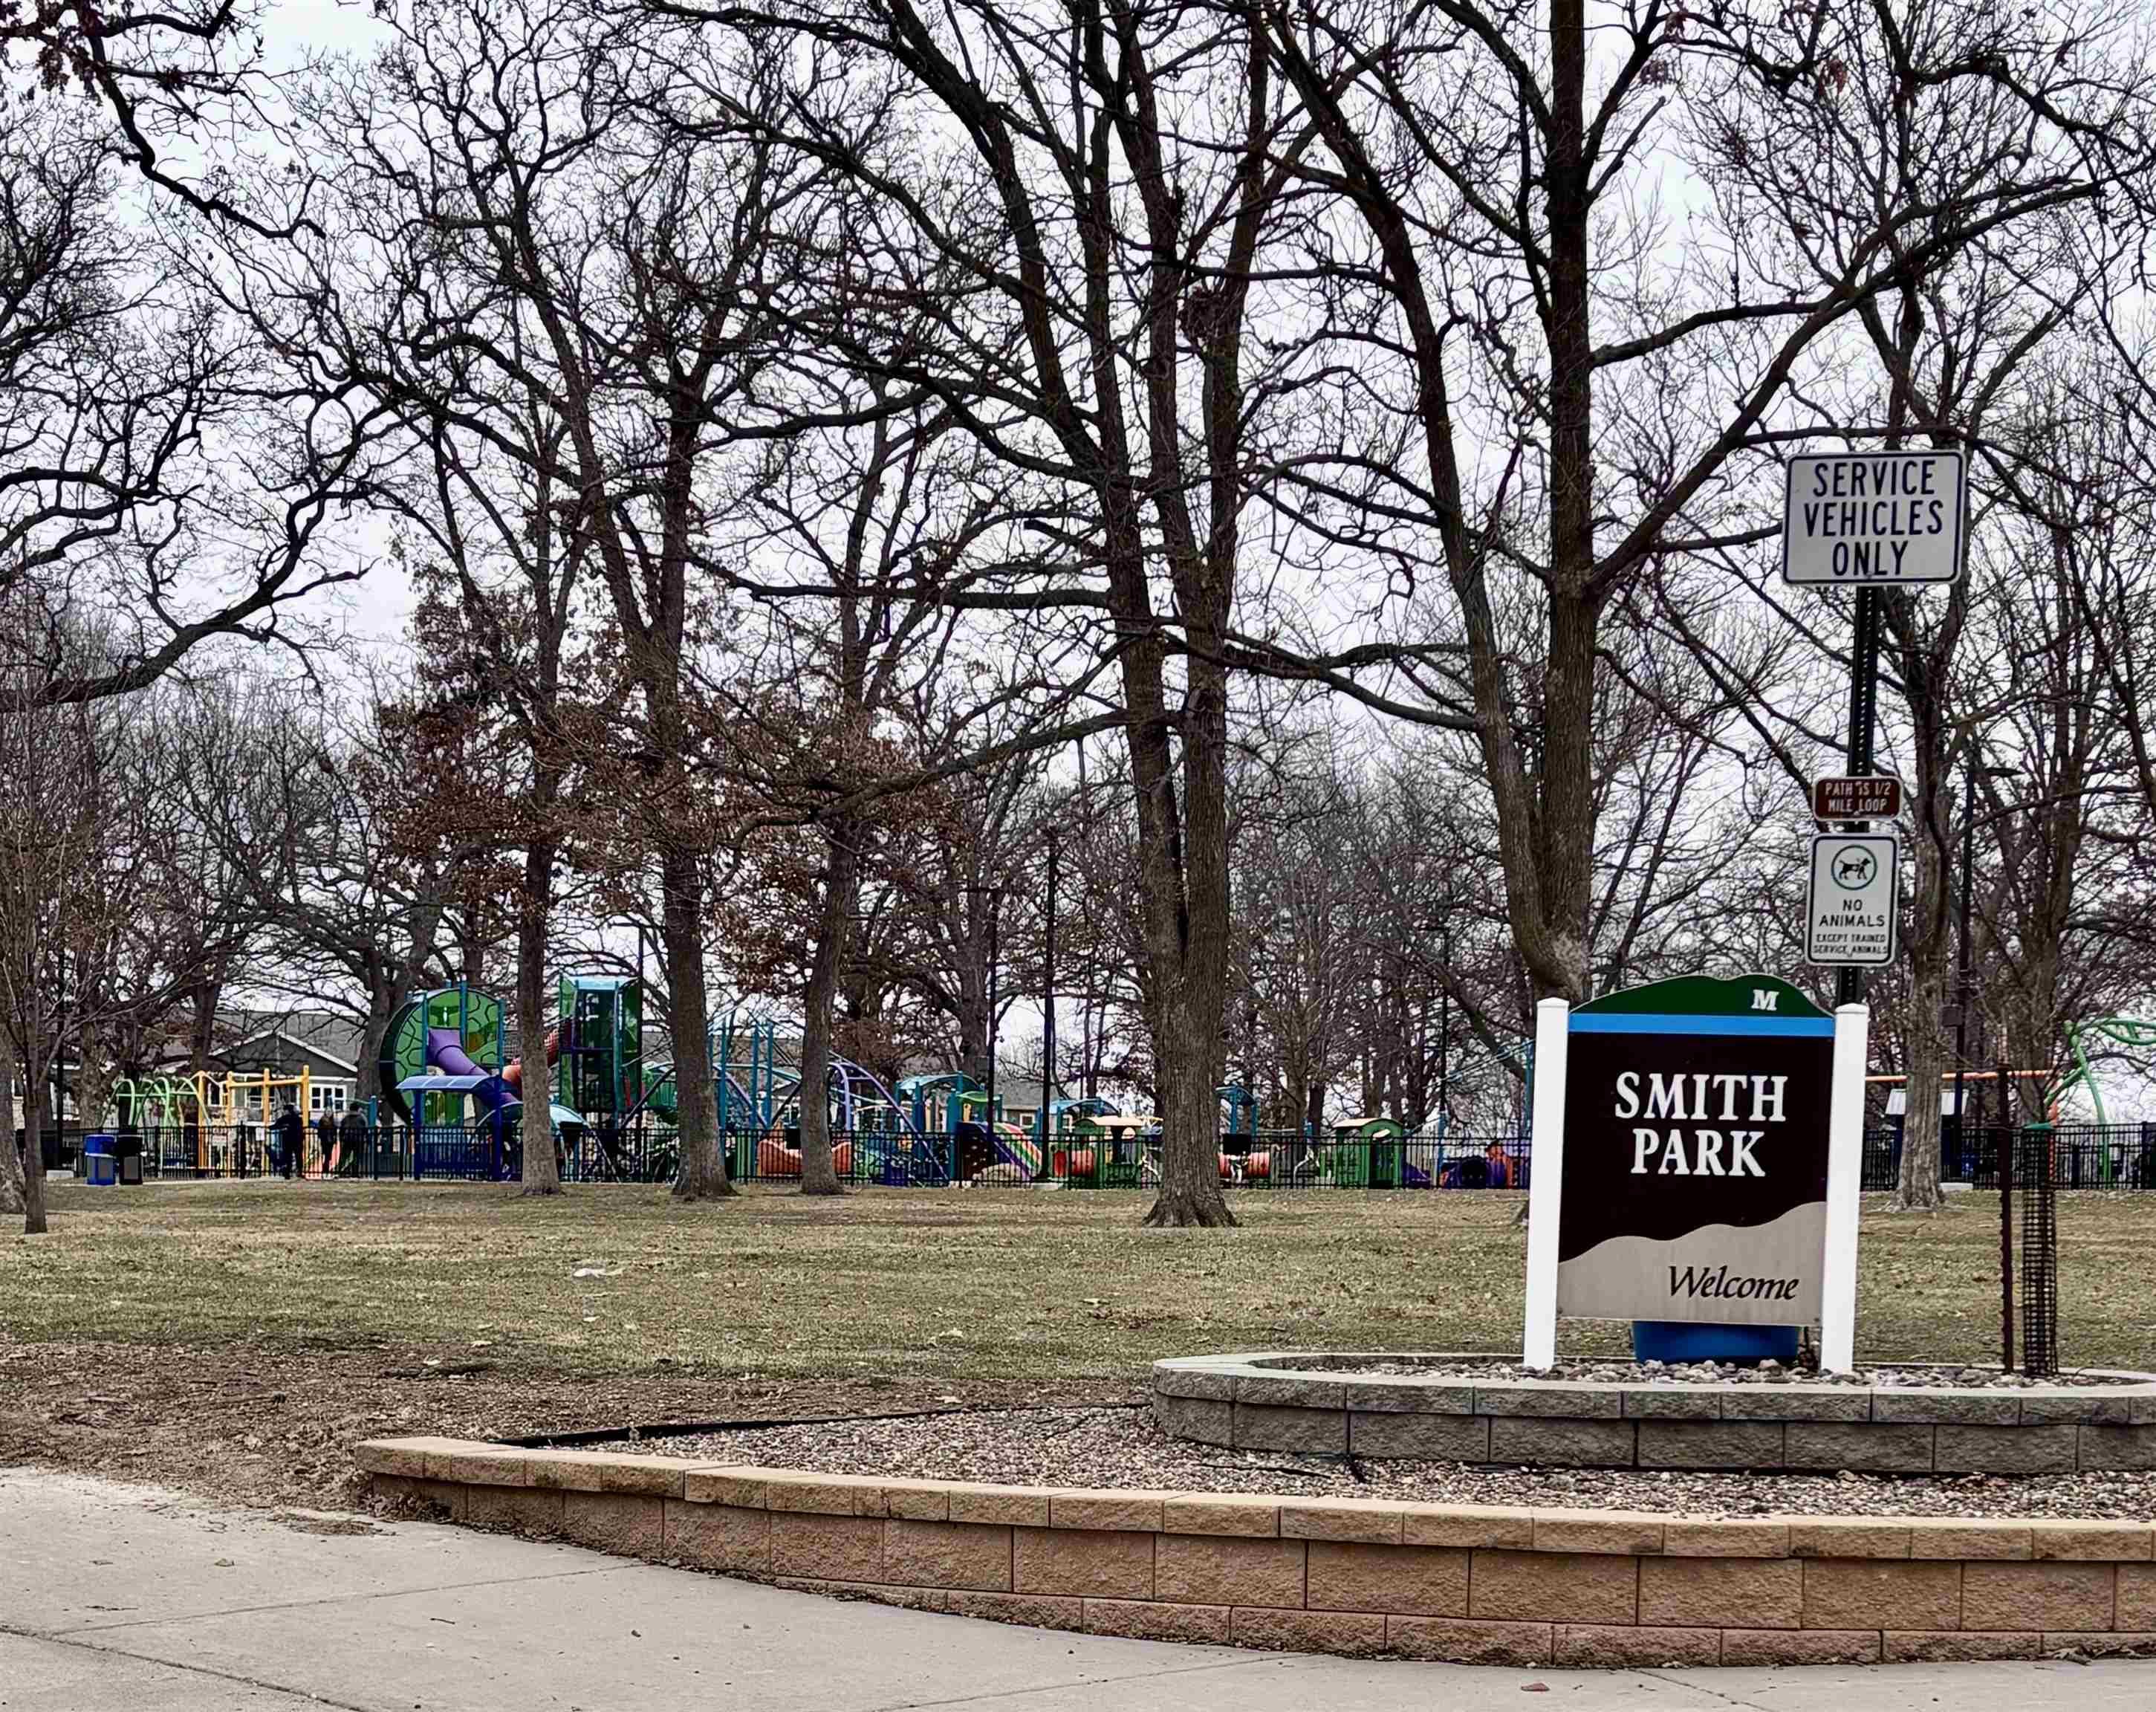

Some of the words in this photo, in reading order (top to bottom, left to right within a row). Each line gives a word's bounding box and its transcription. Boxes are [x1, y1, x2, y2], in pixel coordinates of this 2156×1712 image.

[1813, 460, 1936, 497] SERVICE
[1804, 499, 1944, 536] VEHICLES
[1832, 540, 1908, 576] ONLY
[1825, 782, 1853, 796] PATH
[1828, 798, 1854, 812] MILE
[1858, 798, 1887, 812] LOOP
[1842, 899, 1863, 911] NO
[1819, 915, 1885, 927] ANIMALS
[1816, 933, 1848, 942] EXCEPT
[1851, 934, 1886, 942] TRAINED
[1814, 944, 1848, 953] SERVICE
[1851, 945, 1888, 954] ANIMALS
[1751, 989, 1779, 1011] M
[1614, 1071, 1788, 1122] SMITH
[1631, 1128, 1766, 1177] PARK
[1668, 1265, 1799, 1300] Welcome
